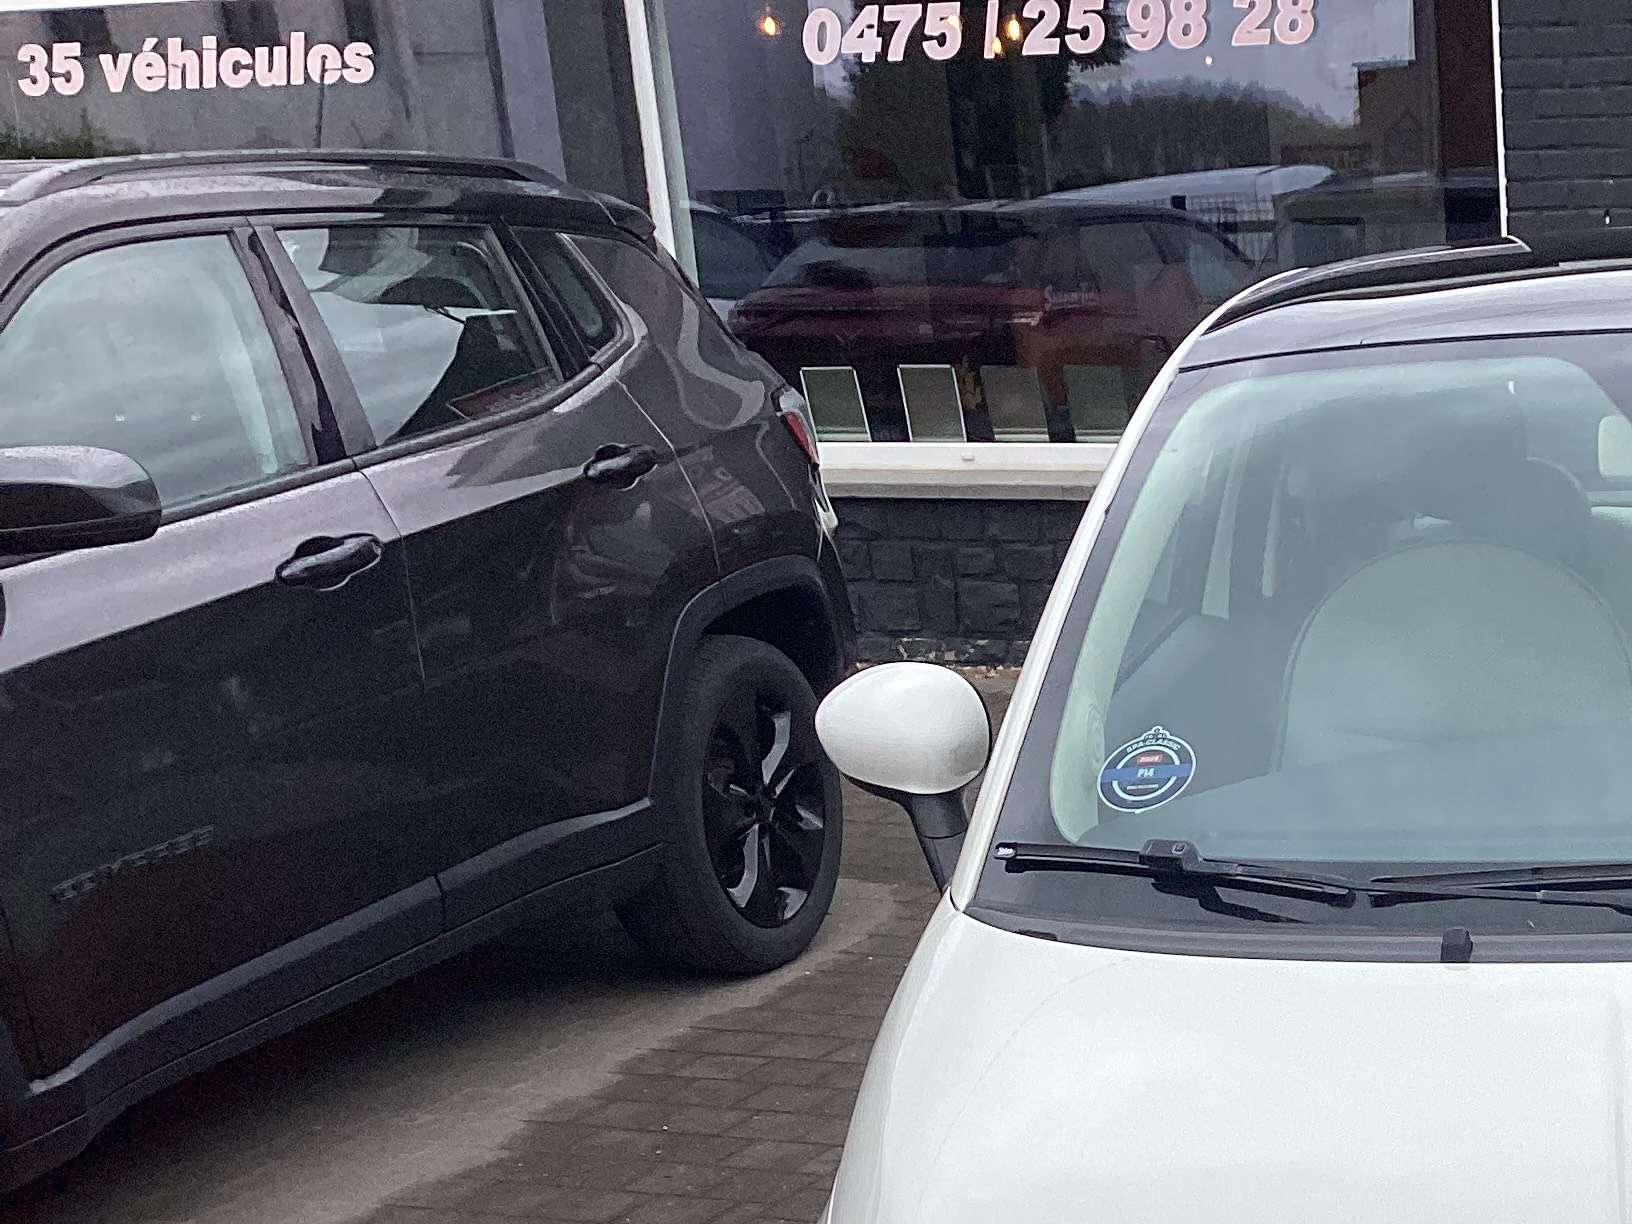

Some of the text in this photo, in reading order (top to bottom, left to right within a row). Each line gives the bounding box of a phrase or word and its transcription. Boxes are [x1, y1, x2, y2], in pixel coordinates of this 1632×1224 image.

[17, 31, 375, 97] 35 véhicules
[803, 2, 962, 65] 0475
[1022, 0, 1106, 55] 25
[1126, 0, 1207, 50] 98
[1231, 0, 1316, 45] 28
